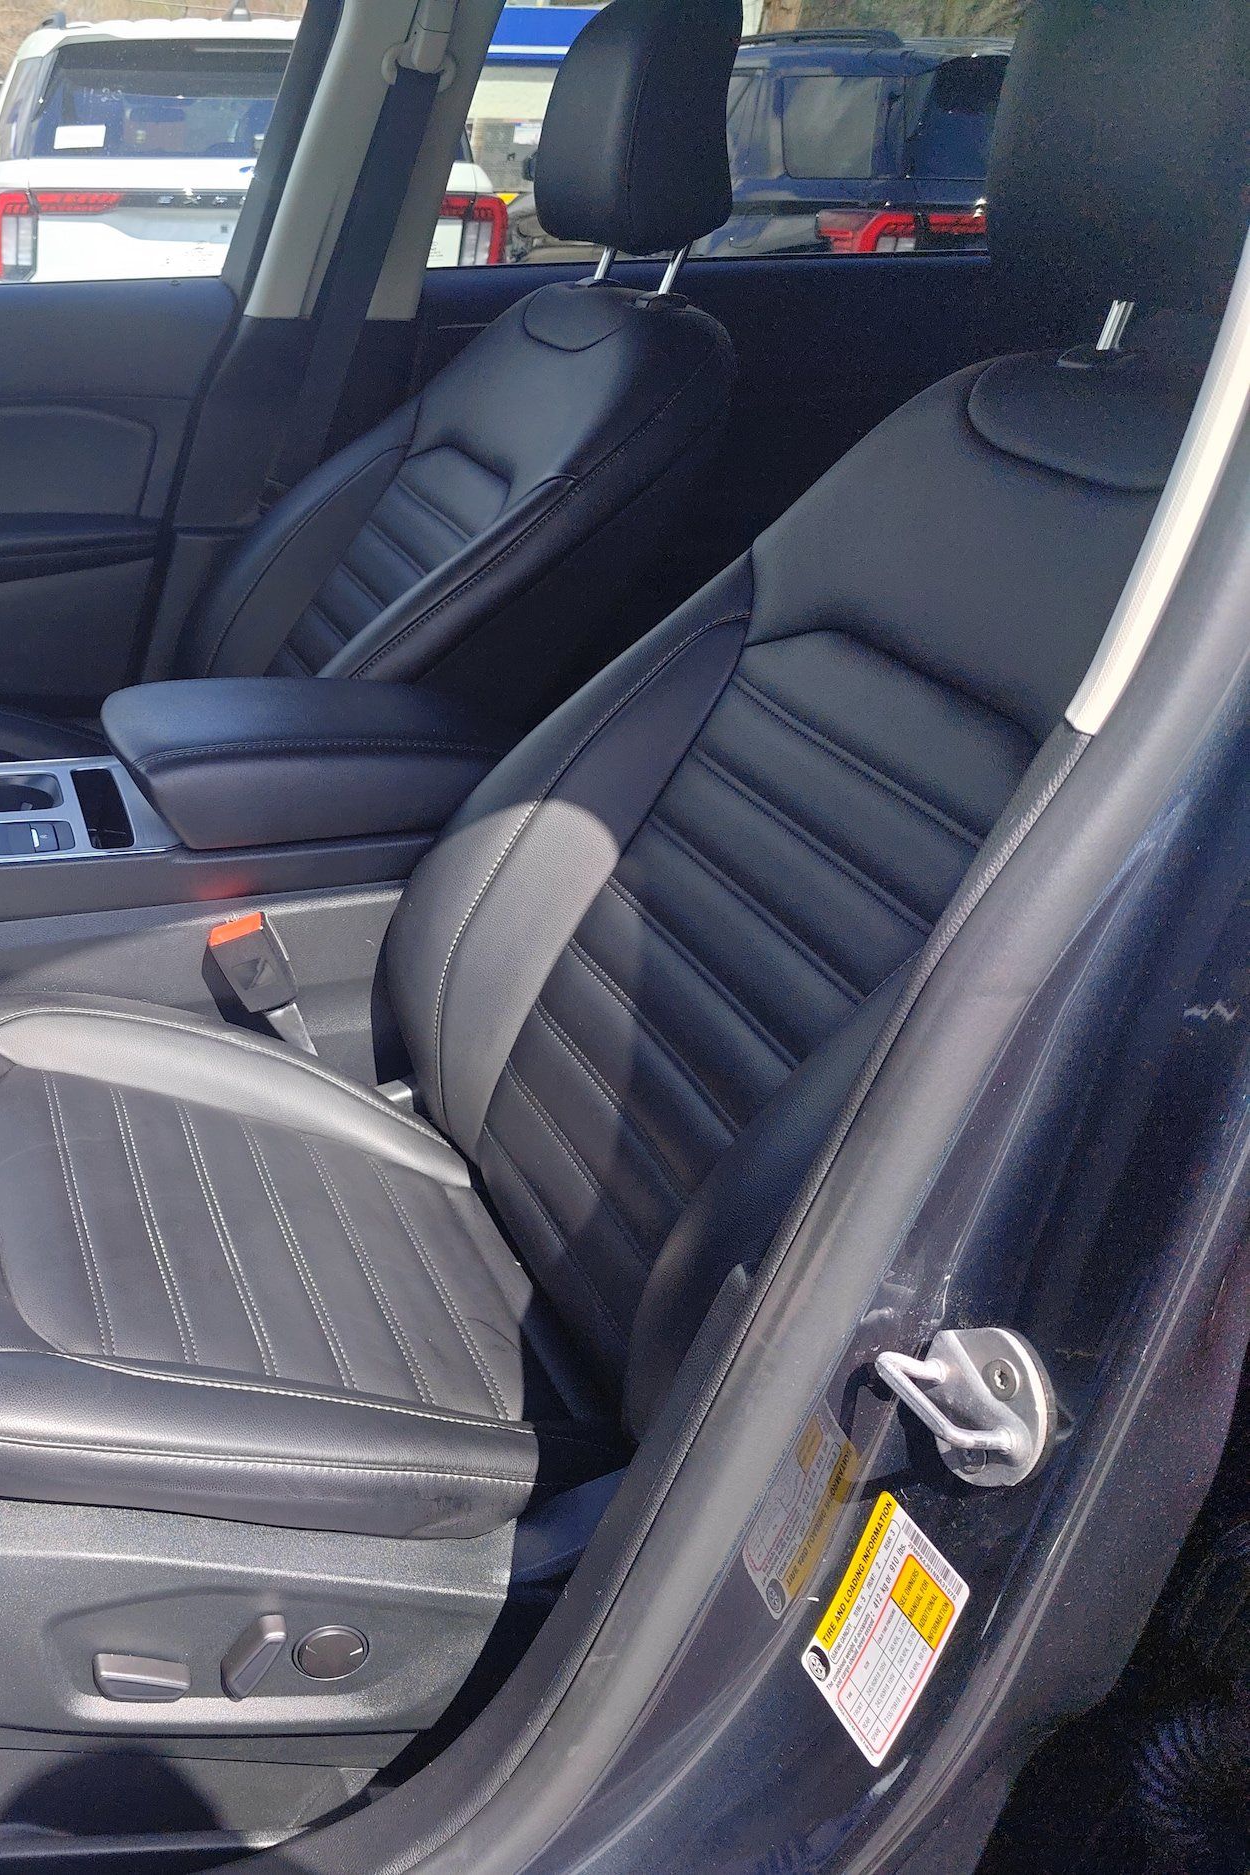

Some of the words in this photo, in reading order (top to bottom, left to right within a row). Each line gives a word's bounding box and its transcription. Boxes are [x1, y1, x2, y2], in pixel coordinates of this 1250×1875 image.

[822, 1620, 836, 1645] TIRE
[833, 1600, 846, 1623] AND
[843, 1562, 865, 1604] LOADING
[861, 1498, 893, 1564] INFORMATION
[872, 1592, 882, 1610] 412
[879, 1581, 889, 1595] kg
[884, 1573, 892, 1584] or
[889, 1555, 899, 1573] 910
[896, 1540, 906, 1557] lbs.
[898, 1592, 907, 1608] SEE
[904, 1567, 919, 1596] OWNERS
[907, 1591, 923, 1620] MANUAL
[919, 1578, 929, 1594] FOR
[918, 1591, 938, 1629] ADDITIONAL
[857, 1634, 866, 1650] never
[926, 1599, 950, 1643] INFORMATION
[831, 1656, 847, 1684] combined
[844, 1640, 856, 1661] weight
